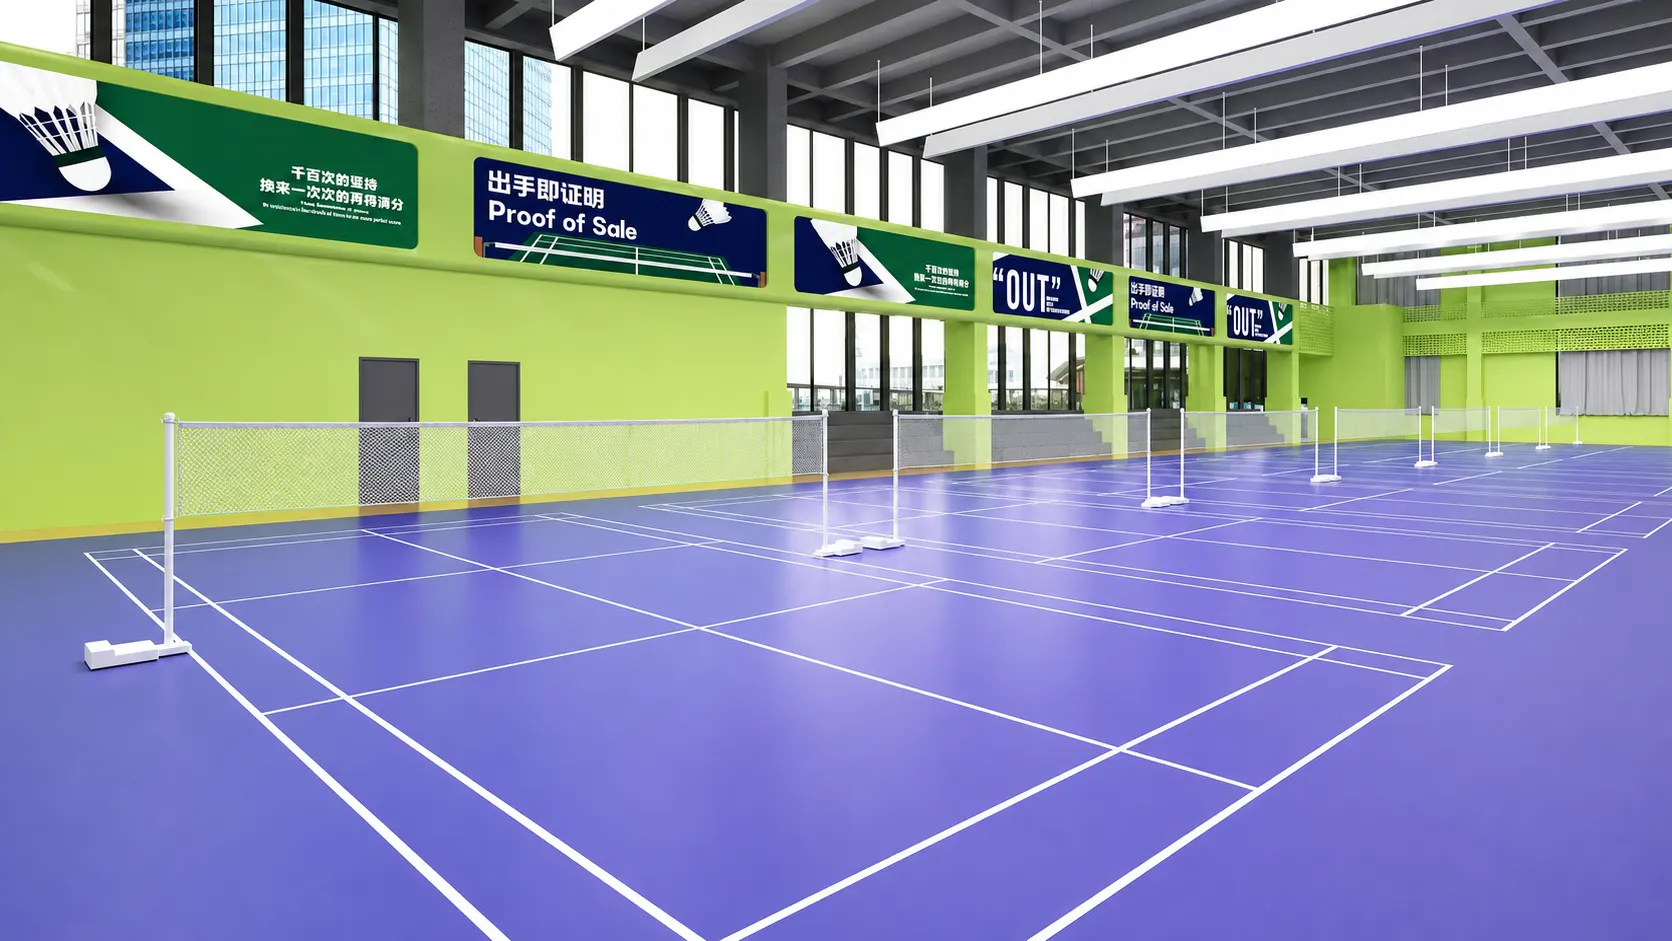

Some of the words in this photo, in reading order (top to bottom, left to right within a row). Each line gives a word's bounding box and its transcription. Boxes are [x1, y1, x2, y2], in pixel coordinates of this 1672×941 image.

[487, 170, 604, 209] 出手即证明
[489, 200, 556, 228] Proof
[563, 213, 586, 233] of
[593, 217, 638, 240] Sale
[1130, 297, 1151, 311] Proof
[1159, 302, 1175, 314] Sale
